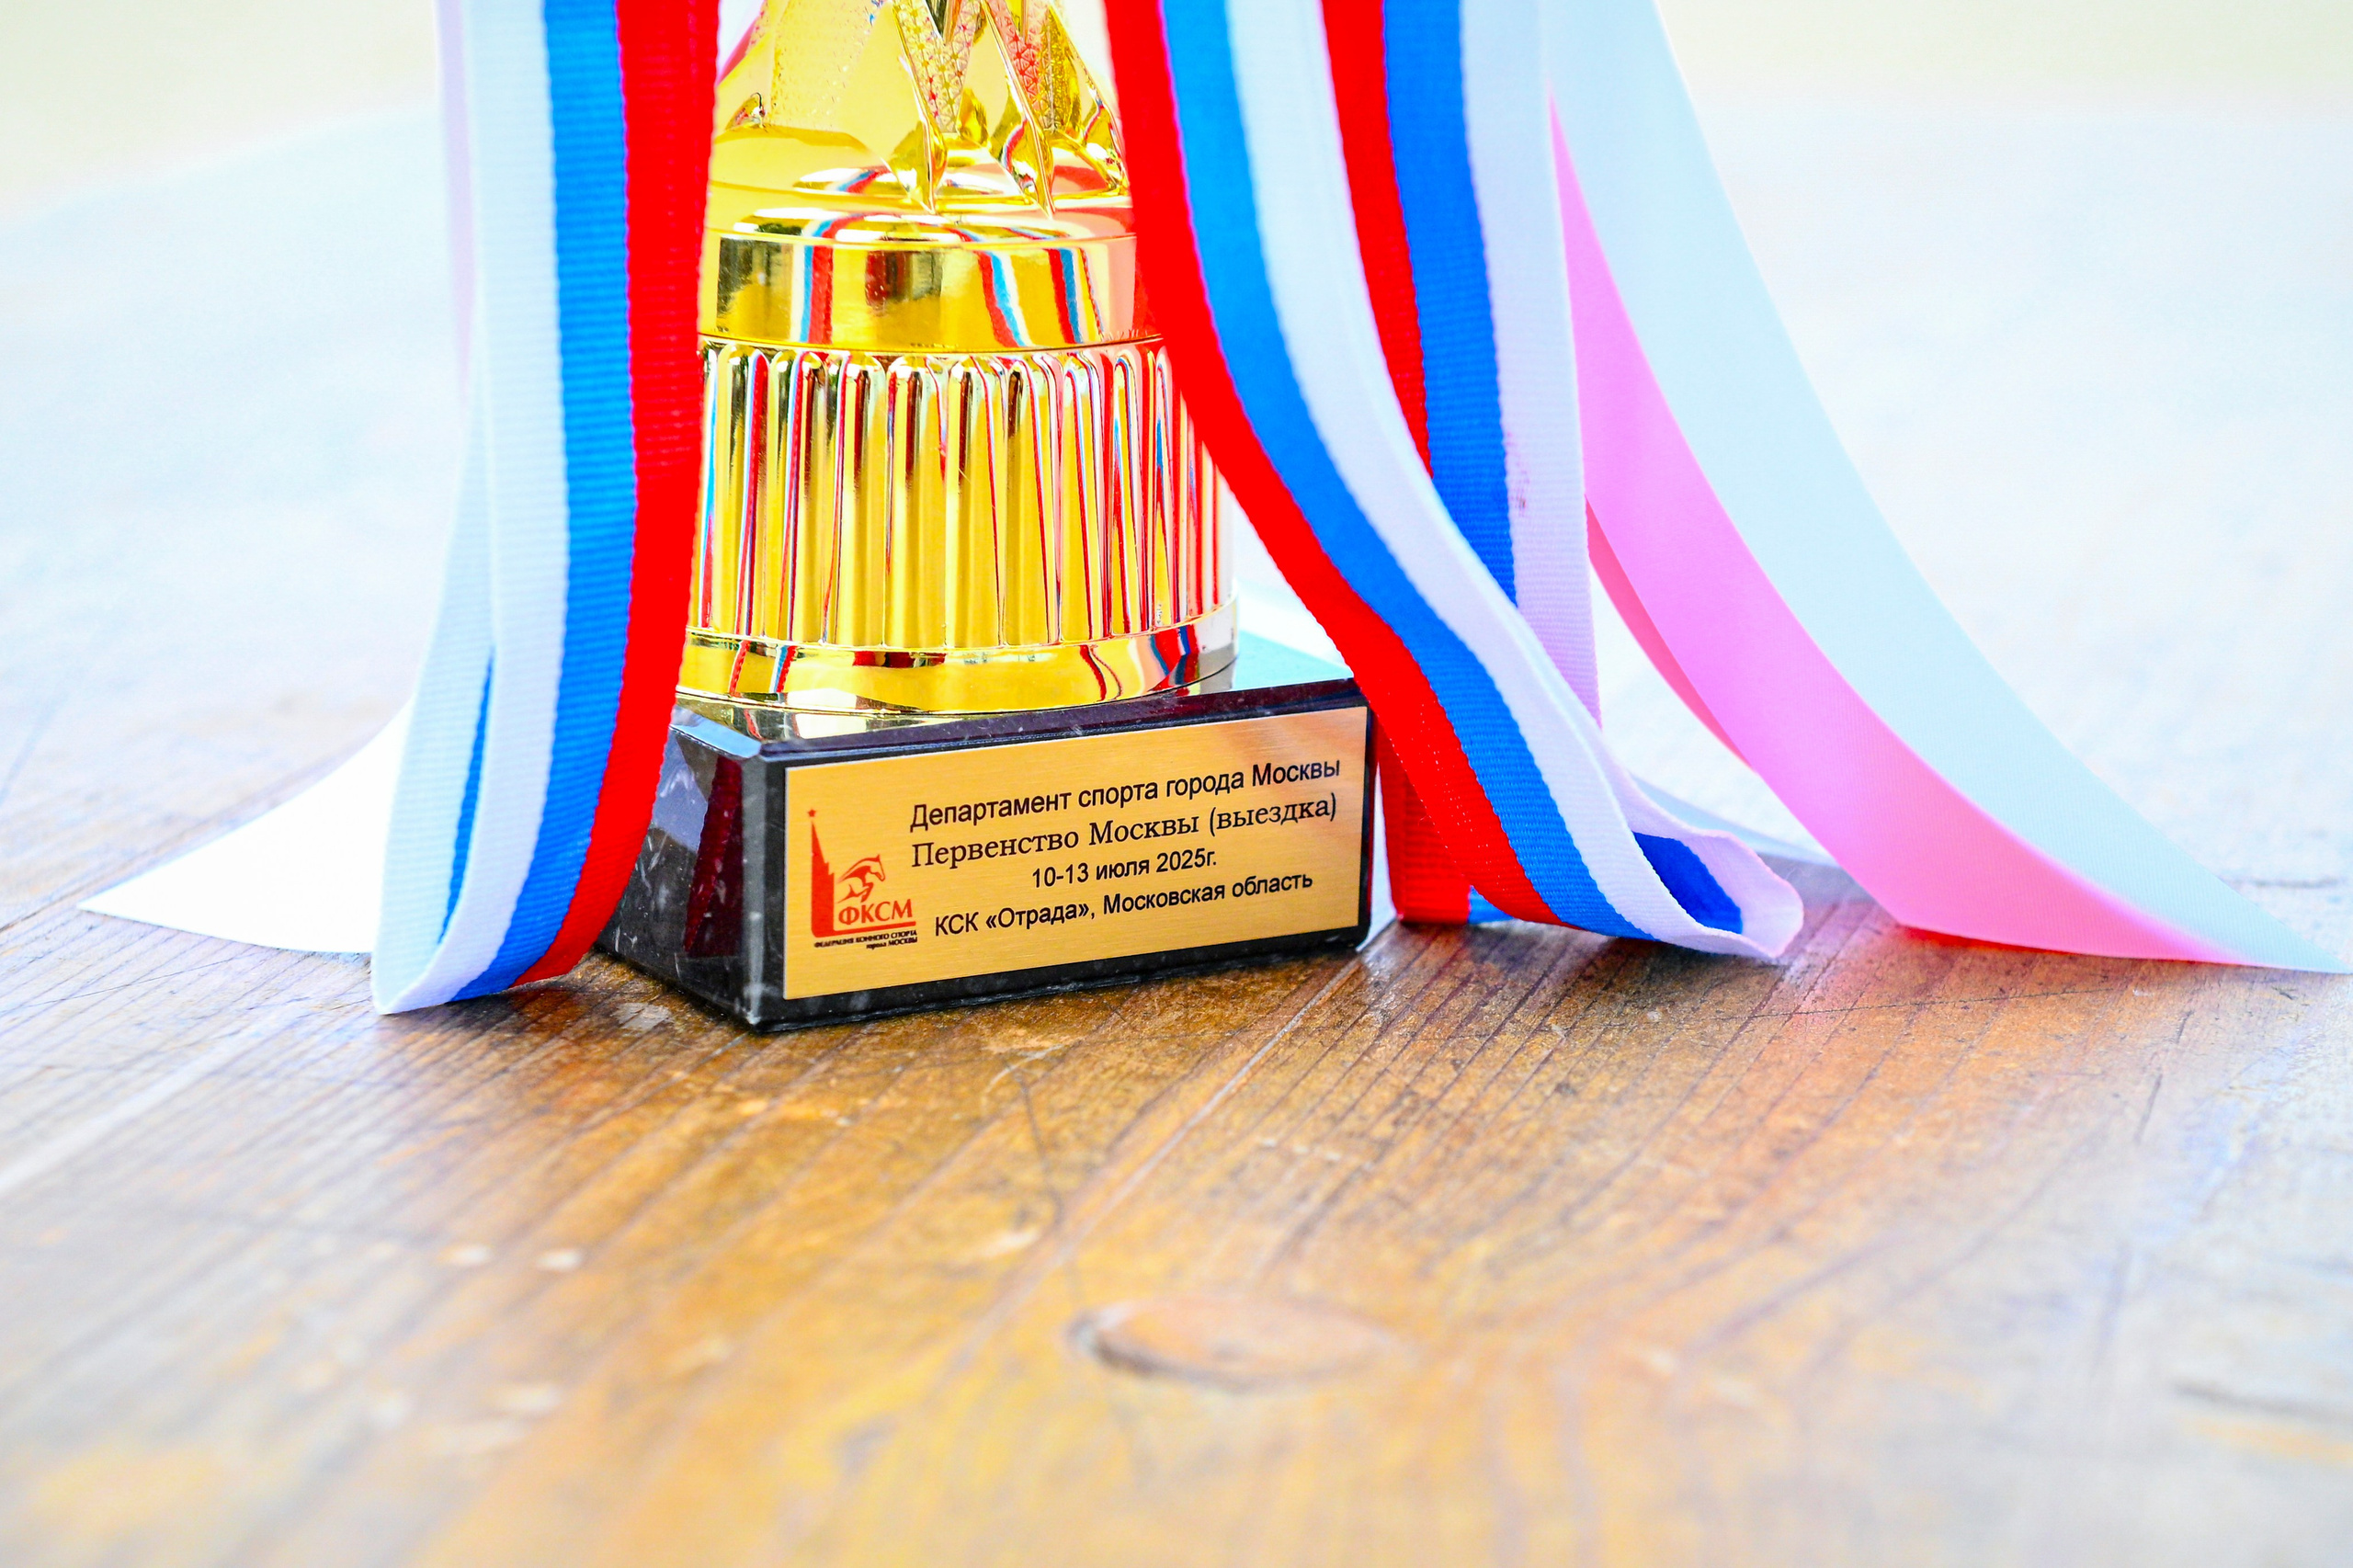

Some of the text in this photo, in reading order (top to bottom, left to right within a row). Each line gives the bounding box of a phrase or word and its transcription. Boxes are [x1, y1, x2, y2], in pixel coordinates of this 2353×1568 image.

[910, 759, 1340, 833] Департамент спорта города Москвы
[911, 792, 1336, 869] Первенство Москвы (выездка)
[1032, 848, 1217, 889] 10-13 июля 2025г.
[838, 899, 913, 926] ФКСМ
[935, 873, 1313, 937] КСК «Отрада», Московская область
